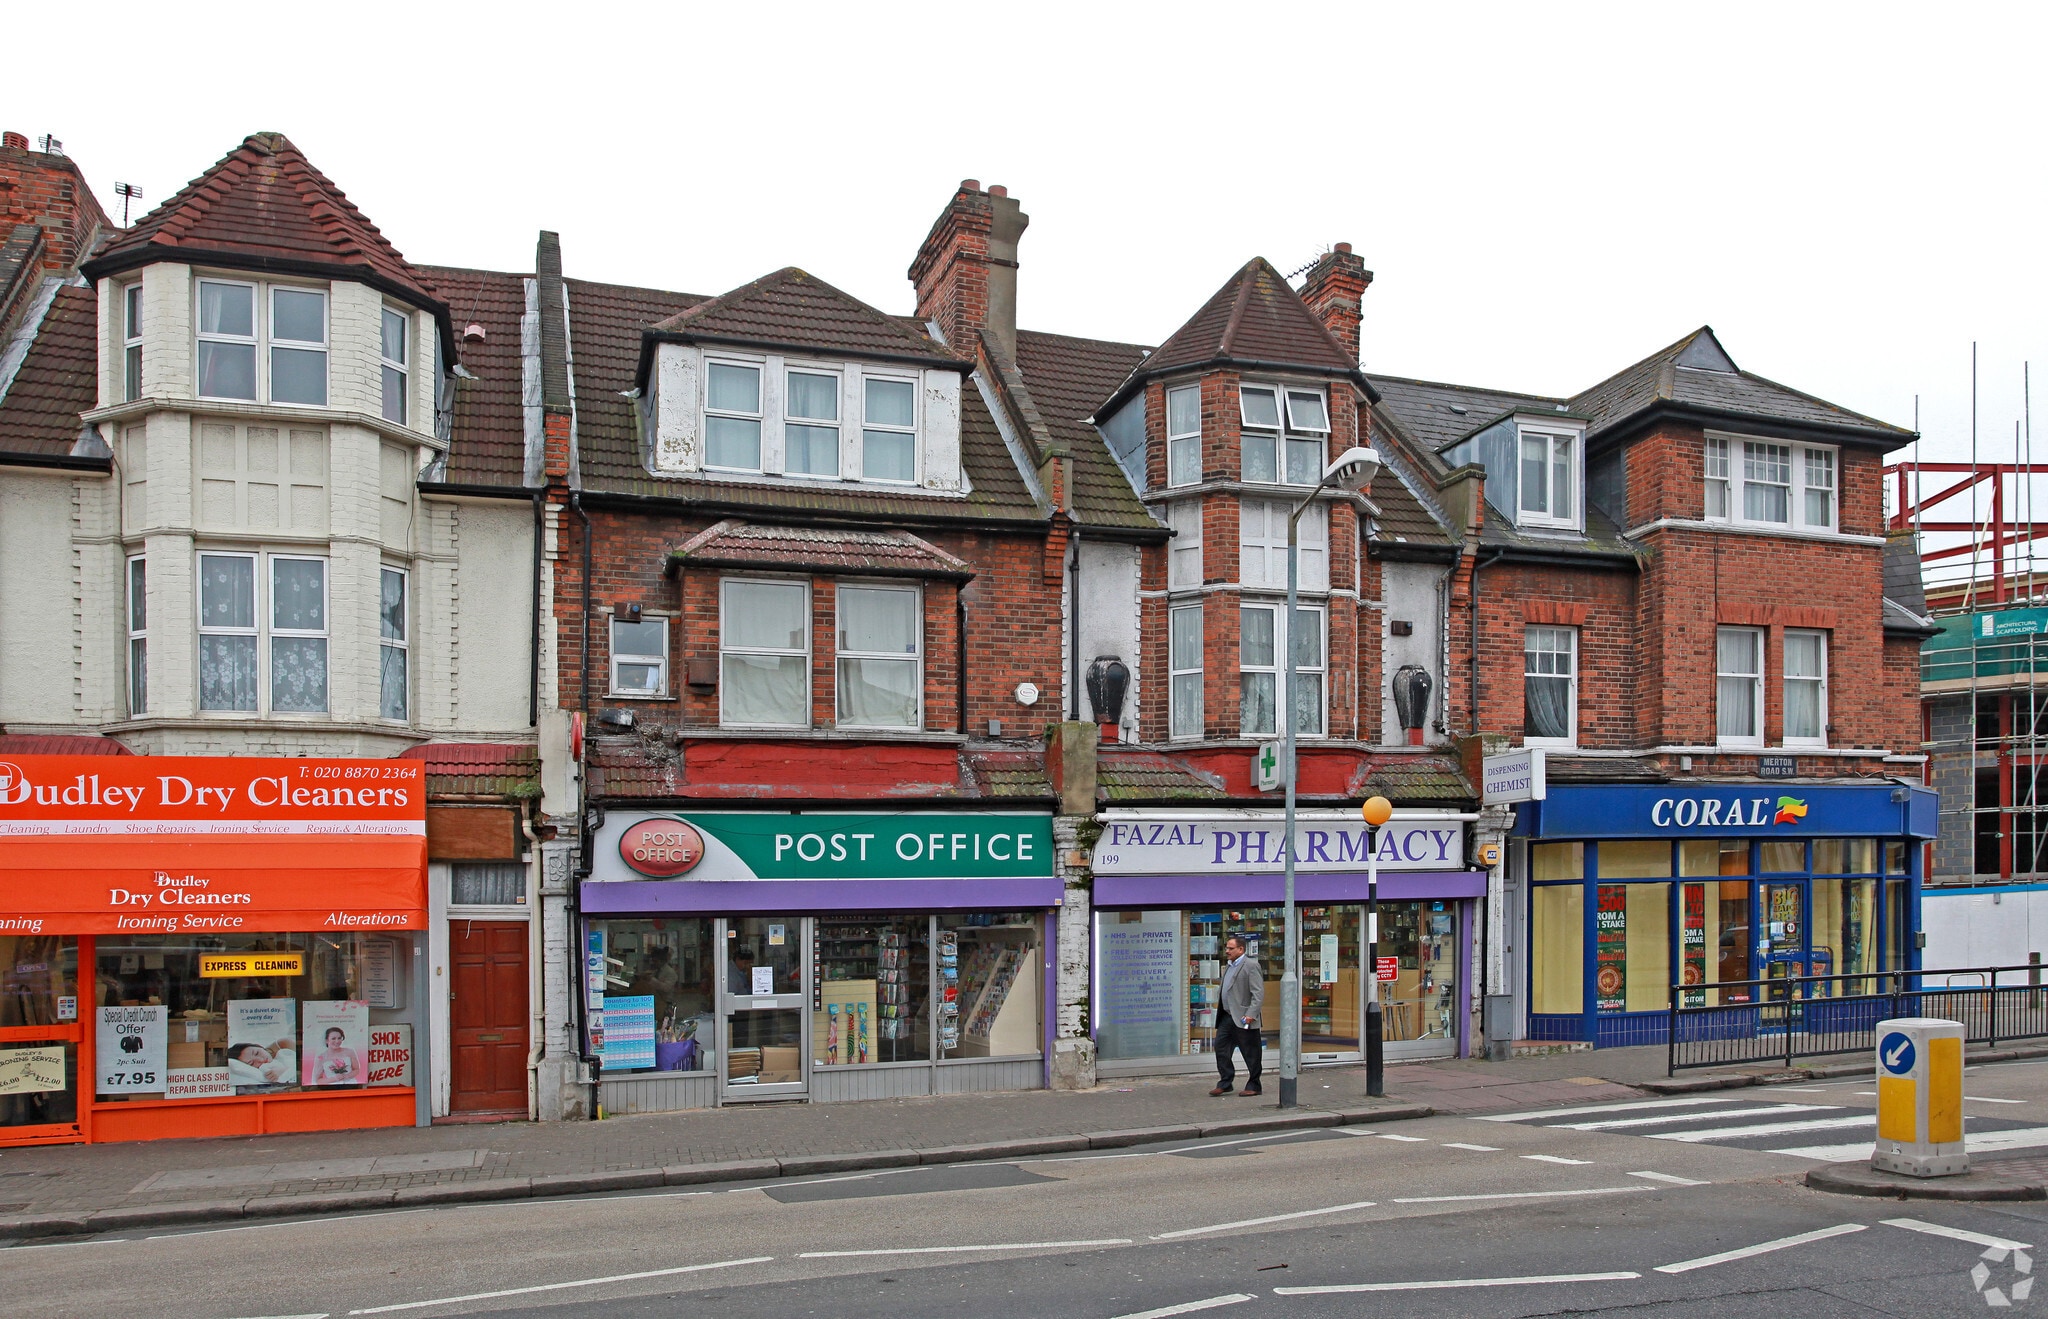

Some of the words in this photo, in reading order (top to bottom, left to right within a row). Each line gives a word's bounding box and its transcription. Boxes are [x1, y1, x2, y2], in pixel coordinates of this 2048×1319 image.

[1996, 620, 2037, 629] ARCHITECTURAL
[1996, 626, 2038, 635] SCAFFOLDING
[1763, 758, 1792, 766] MERTON
[314, 767, 341, 779] 020
[344, 767, 379, 779] 8870
[382, 768, 417, 779] 2364
[1487, 762, 1529, 776] DISPENSING
[1761, 767, 1780, 775] ROAD
[1486, 777, 1531, 793] CHEMIST
[0, 773, 146, 812] Dudley
[156, 776, 236, 812] Dry
[247, 776, 408, 807] Cleaners
[64, 824, 112, 834] Laundry
[125, 824, 153, 834] Shoe
[156, 824, 197, 834] Repairs
[210, 824, 248, 834] Ironing
[251, 824, 290, 833] Service
[354, 824, 409, 833] Alterations
[642, 832, 686, 847] POST
[1110, 824, 1204, 846] FAZAL
[1211, 830, 1457, 864] PHARMACY
[774, 833, 875, 862] POST
[895, 832, 1033, 861] OFFICE
[633, 848, 691, 863] OFFICE
[1101, 855, 1119, 865] 199
[109, 889, 153, 908] Dry
[159, 888, 251, 905] Cleaners
[1772, 887, 1798, 906] BIG
[1598, 895, 1625, 912] 500
[0, 917, 43, 933] aning
[117, 915, 178, 932] Ironing
[182, 914, 243, 928] Service
[324, 911, 408, 926] Alterations
[1597, 911, 1617, 921] ROM
[1618, 911, 1625, 920] A
[1601, 920, 1625, 929] STAKE
[1684, 929, 1697, 937] OM
[1698, 928, 1704, 936] A
[1684, 936, 1704, 944] STAKE
[205, 961, 247, 971] EXPRESS
[254, 960, 298, 971] CLEANING
[1131, 968, 1167, 976] DELIVERY
[604, 998, 631, 1006] counting
[104, 1007, 123, 1025] Special
[124, 1007, 139, 1022] Credit
[139, 1007, 158, 1022] Crunch
[116, 1023, 146, 1035] Offer
[371, 1031, 401, 1045] SHOE
[0, 1056, 29, 1067] RONING
[31, 1055, 61, 1064] SERVICE
[116, 1058, 129, 1066] 2pc
[107, 1072, 156, 1085] £7.95
[167, 1075, 184, 1083] HIGH
[186, 1073, 212, 1083] CLASS
[214, 1072, 230, 1082] SHO
[368, 1064, 405, 1082] HERE
[35, 1074, 61, 1085] £12.00
[169, 1084, 197, 1094] REPAIR
[198, 1083, 231, 1093] SERVICE
